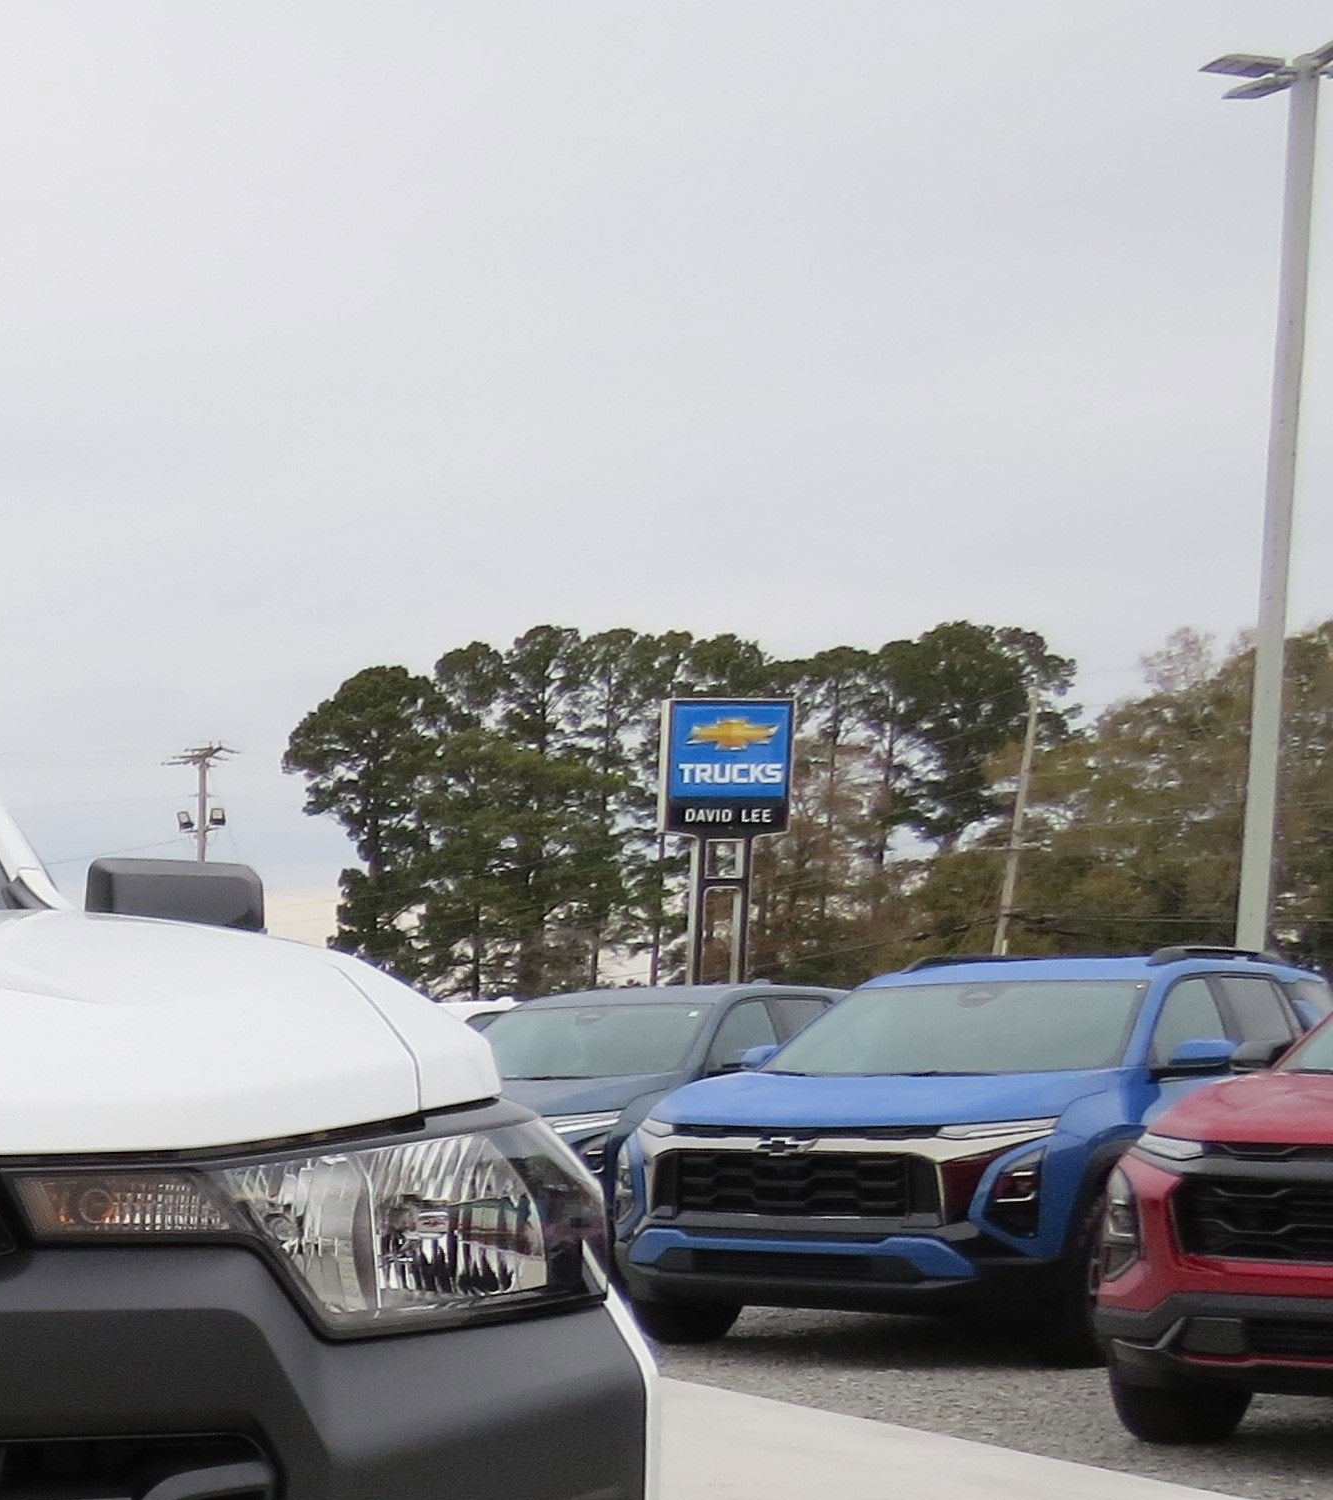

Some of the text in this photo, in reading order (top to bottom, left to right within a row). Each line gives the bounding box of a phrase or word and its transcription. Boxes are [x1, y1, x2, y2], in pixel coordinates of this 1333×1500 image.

[679, 763, 783, 784] TRUCKS
[684, 808, 773, 823] DAVID LEE
